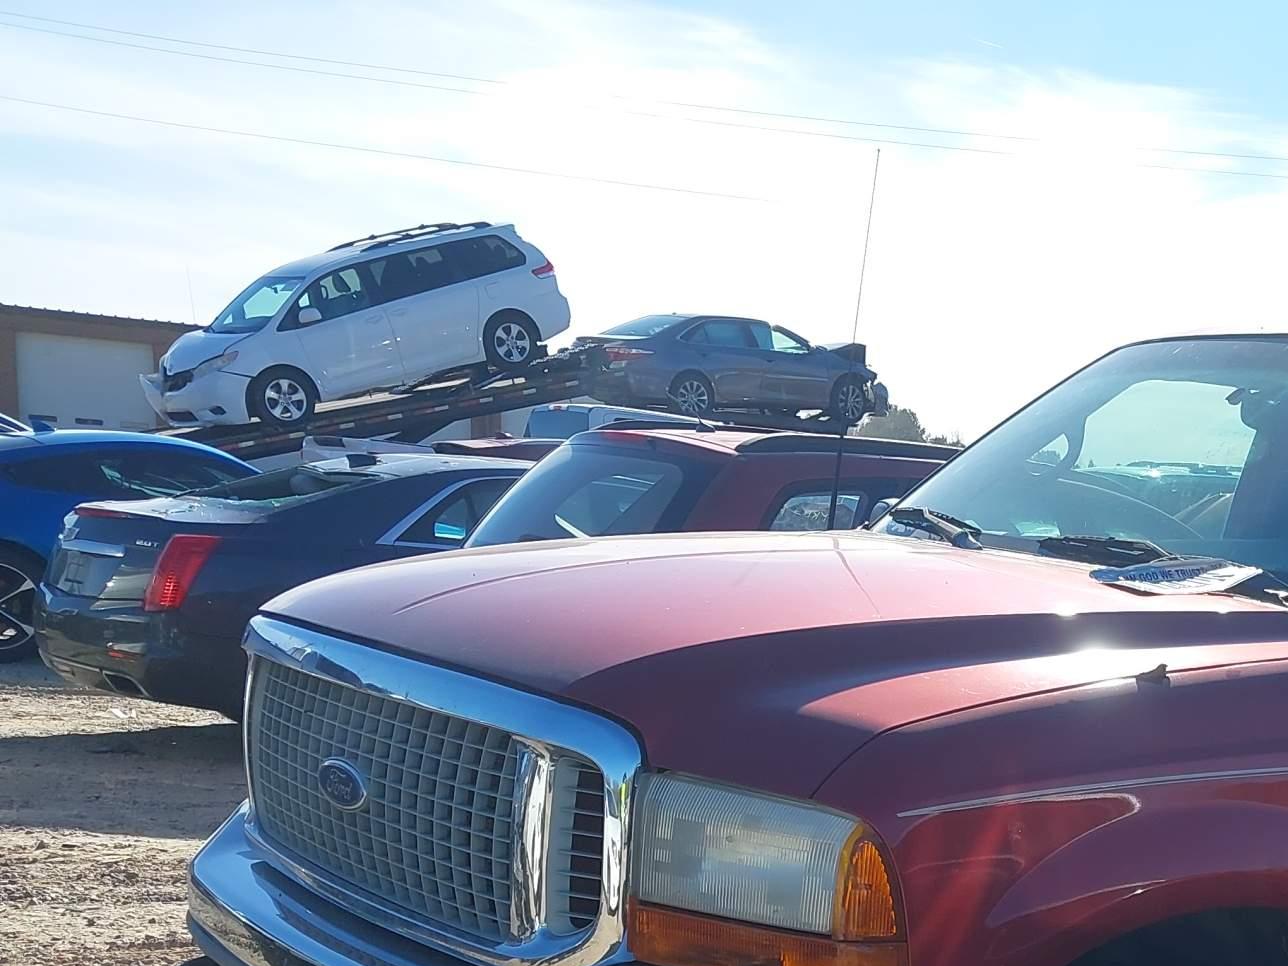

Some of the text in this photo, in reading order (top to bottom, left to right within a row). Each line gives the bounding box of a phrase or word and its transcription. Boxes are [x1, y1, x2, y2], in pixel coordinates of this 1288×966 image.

[1139, 570, 1159, 582] GOD
[1159, 567, 1174, 580] WE
[1175, 566, 1201, 579] TRUST
[325, 767, 354, 801] Ford
